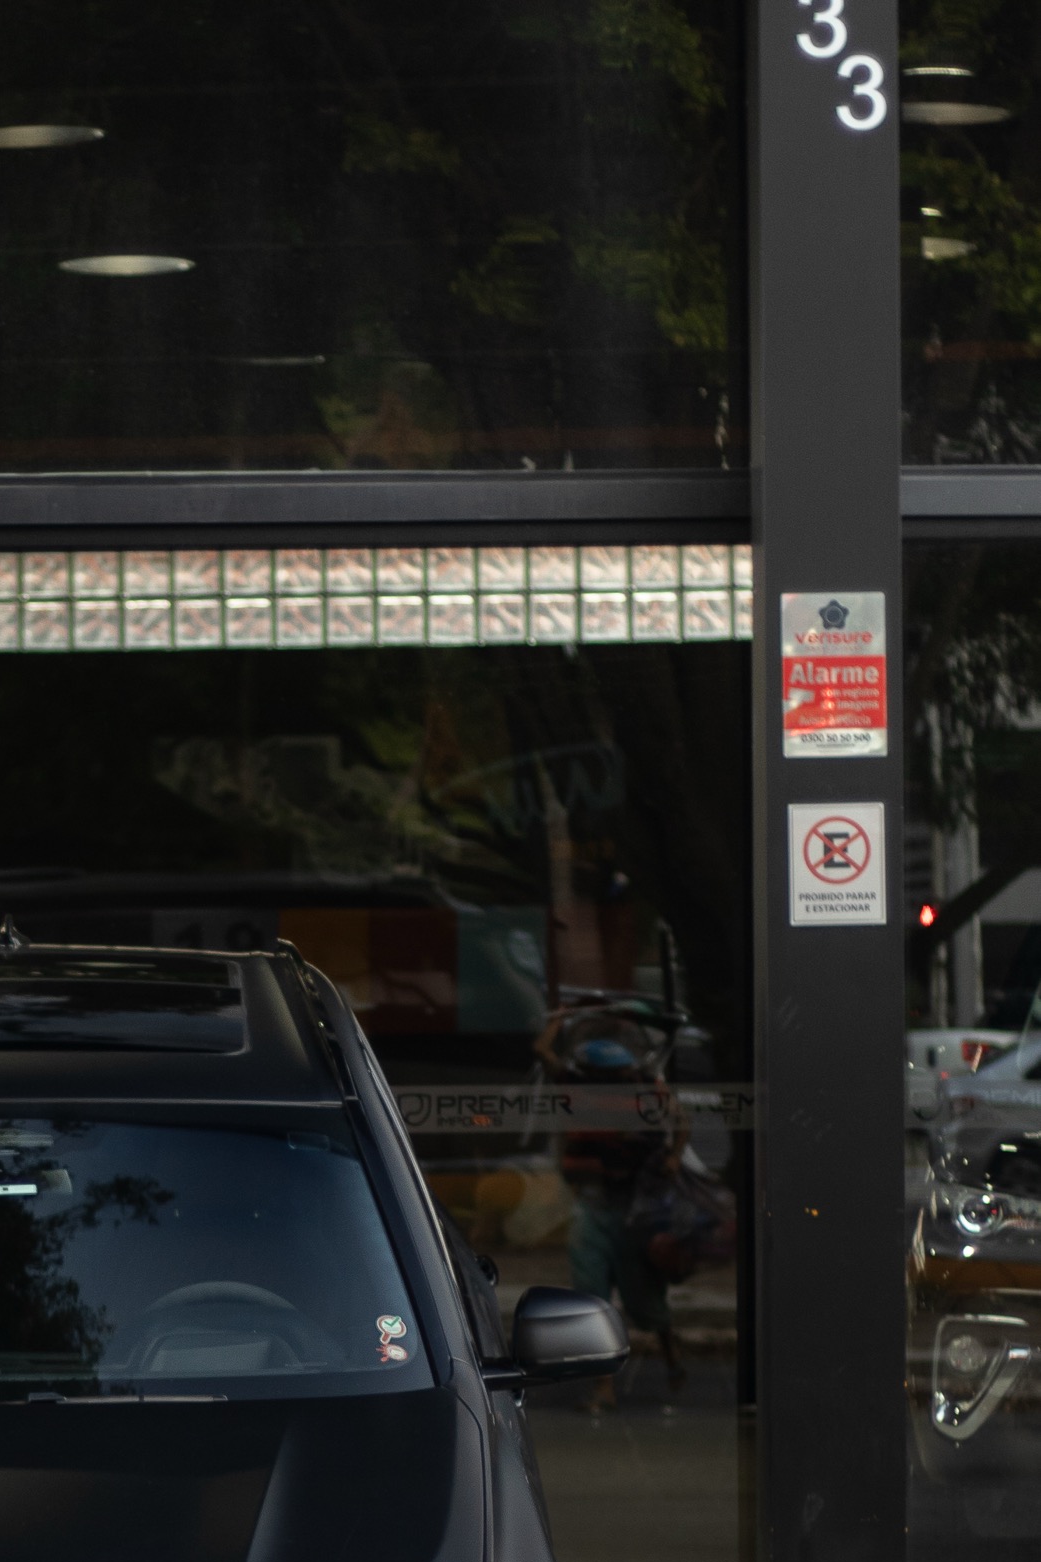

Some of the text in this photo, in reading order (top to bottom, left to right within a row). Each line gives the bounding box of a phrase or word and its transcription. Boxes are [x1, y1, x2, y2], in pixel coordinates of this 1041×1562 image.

[796, 0, 848, 58] 3
[835, 54, 887, 131] 3
[795, 632, 872, 644] verisure
[790, 662, 879, 684] Alarme
[799, 891, 876, 901] PROIBIDO PARAR
[805, 903, 870, 913] E ESTACIONAR
[436, 1094, 574, 1116] PREMIER
